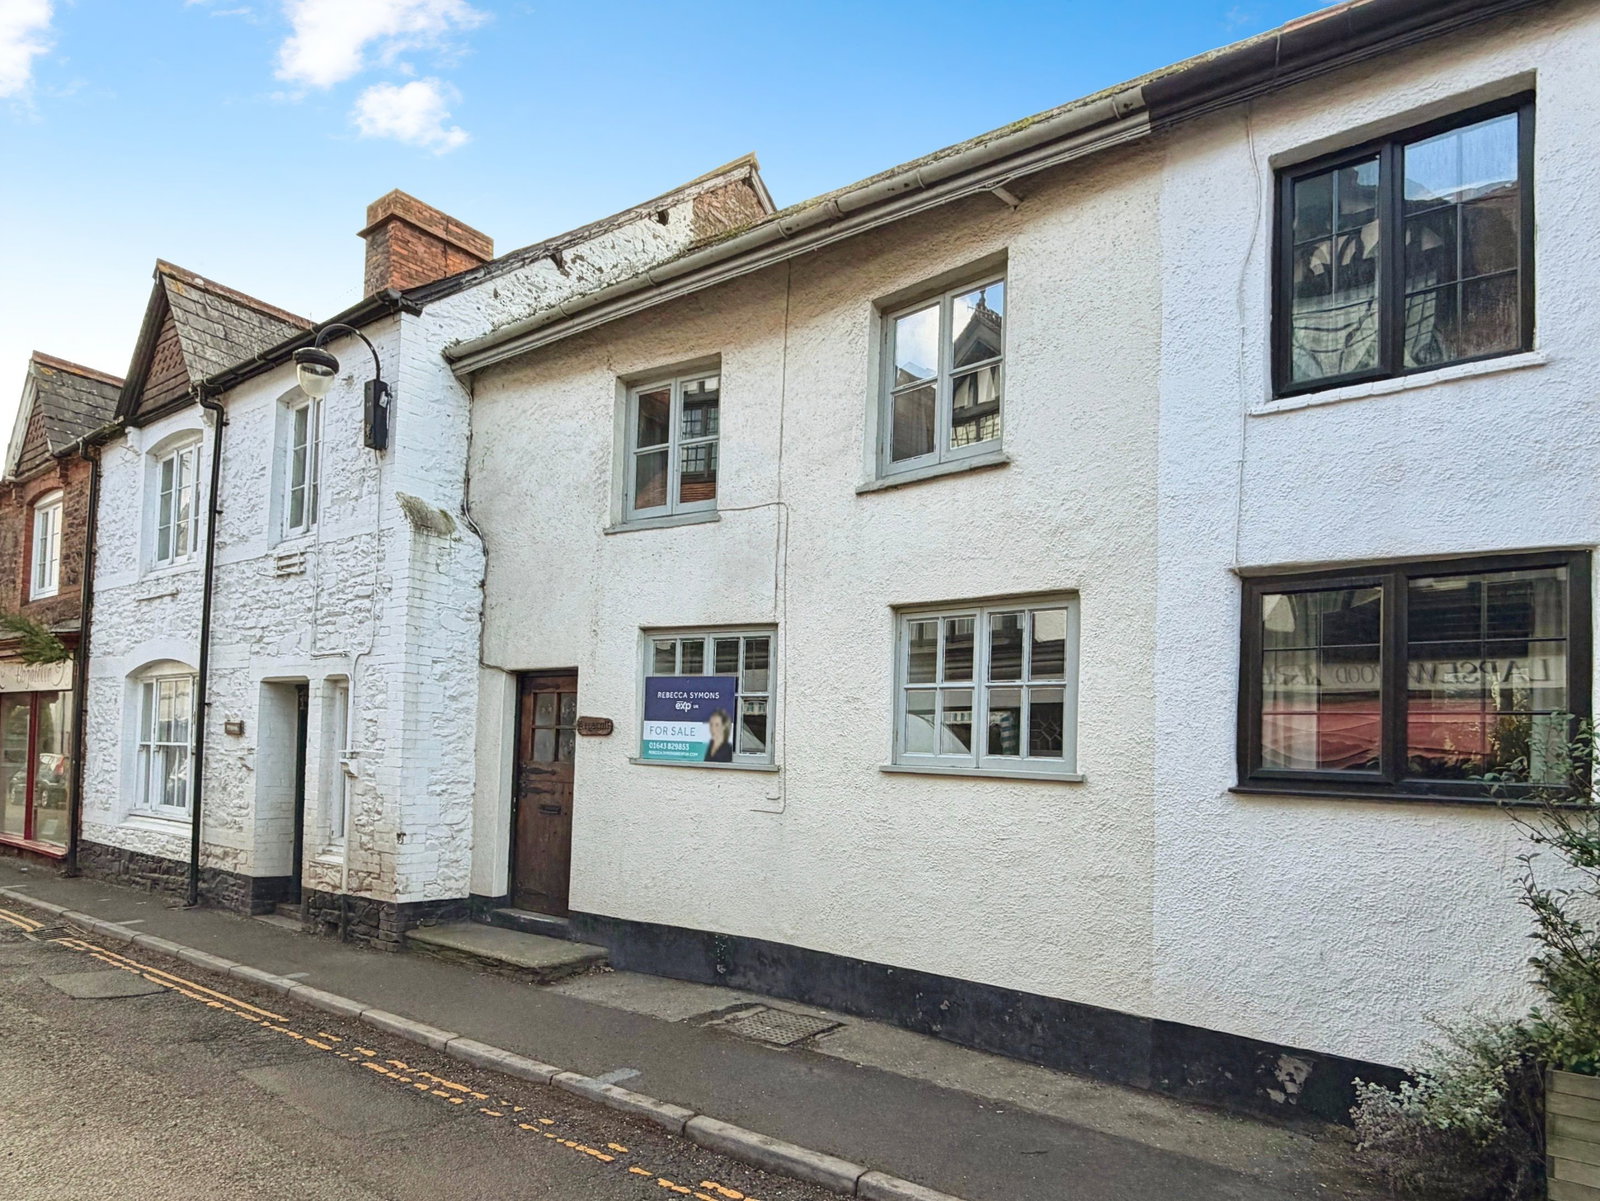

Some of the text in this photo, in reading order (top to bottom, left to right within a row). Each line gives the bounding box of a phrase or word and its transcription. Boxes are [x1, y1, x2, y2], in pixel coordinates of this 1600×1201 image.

[657, 691, 719, 699] REBECCA SYMONS
[649, 726, 696, 737] FOR SALE
[648, 742, 690, 751] 01643 829853
